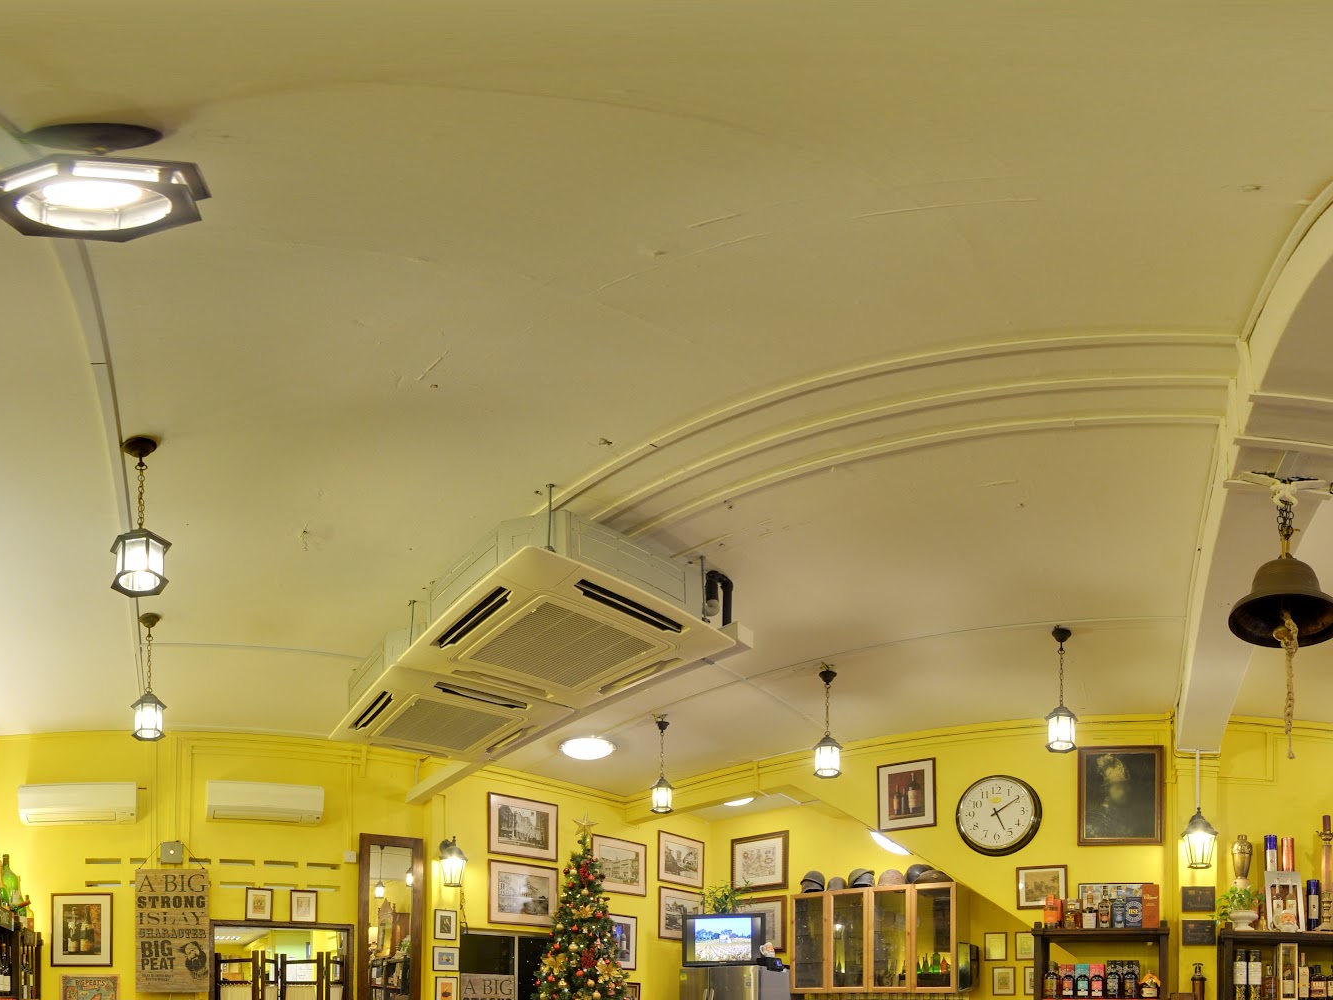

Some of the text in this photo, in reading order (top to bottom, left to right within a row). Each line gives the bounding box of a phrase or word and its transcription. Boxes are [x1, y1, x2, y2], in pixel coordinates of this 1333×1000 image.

[138, 874, 207, 893] A BIG
[137, 895, 207, 909] STRONG
[138, 911, 206, 925] ISLAY
[138, 927, 207, 939] CHARACTER
[140, 939, 174, 959] BIG
[140, 956, 176, 971] PEAT
[482, 982, 513, 996] BIG
